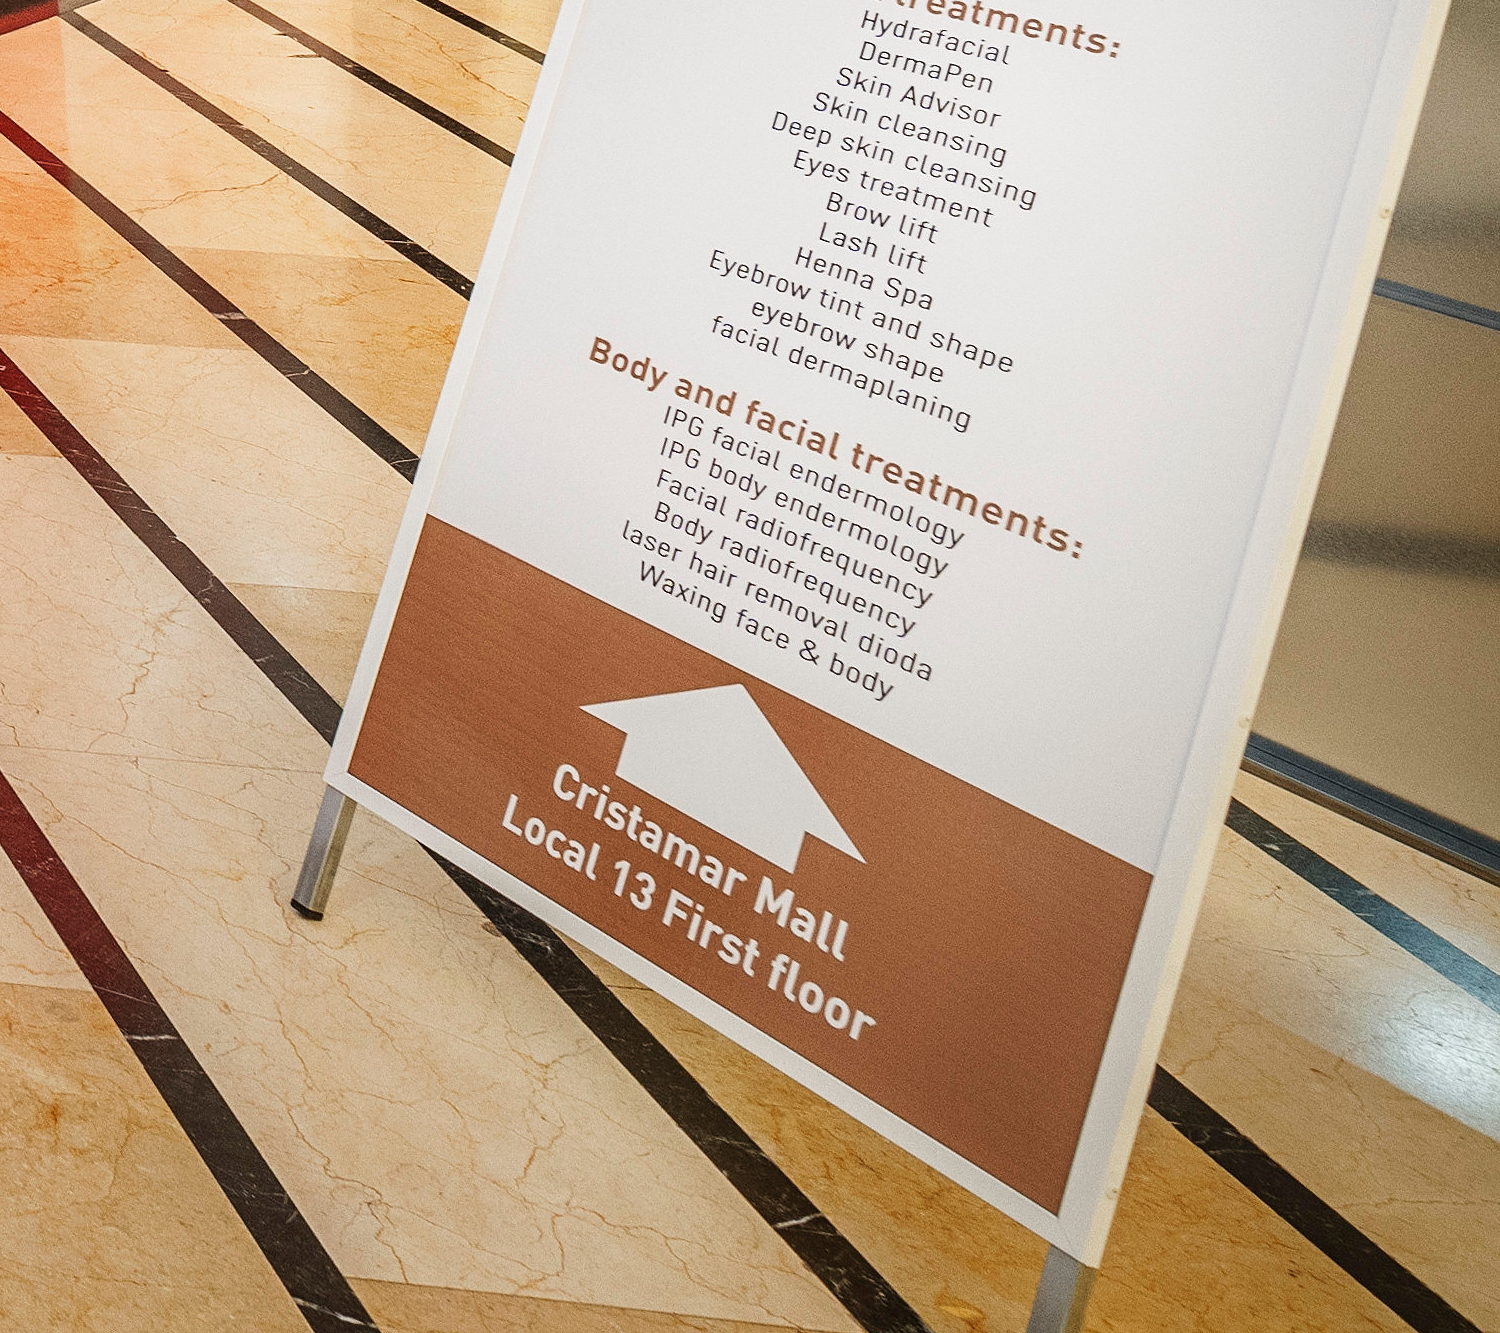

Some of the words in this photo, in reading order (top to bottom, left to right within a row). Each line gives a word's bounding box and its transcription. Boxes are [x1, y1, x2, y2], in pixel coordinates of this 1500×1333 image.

[859, 41, 993, 93] DermaPen
[861, 10, 1009, 65] Hydrafacial
[813, 92, 868, 124] Skin
[878, 114, 1007, 168] cleansing
[836, 67, 892, 98] Skin
[900, 85, 1001, 127] Advisor
[771, 111, 832, 148] Deep
[840, 136, 894, 164] skin
[904, 154, 1037, 211] cleansing
[793, 149, 850, 183] Eyes
[860, 171, 993, 228] treatment
[819, 222, 878, 258] Lash
[888, 244, 927, 274] lift
[826, 191, 891, 227] Brow
[899, 214, 938, 244] lift
[710, 249, 811, 300] Eyebrow
[820, 289, 864, 320] tint
[872, 312, 922, 340] and
[930, 332, 1013, 373] shape
[795, 246, 874, 290] Henna
[884, 277, 933, 310] Spa
[712, 315, 779, 357] facial
[788, 346, 971, 433] dermaplaning
[752, 302, 857, 350] eyebrow
[863, 343, 944, 383] shape
[589, 336, 668, 392] Body
[674, 378, 737, 417] and
[745, 400, 840, 460] facial
[852, 443, 1083, 559] treatments:
[663, 406, 704, 437] IPG
[712, 426, 780, 471] facial
[790, 463, 965, 549] endermology
[657, 469, 727, 516] Facial
[735, 508, 933, 609] radiofrequency
[660, 437, 701, 469] IPG
[709, 458, 767, 501] body
[775, 492, 949, 579] endermology
[622, 520, 682, 561] laser
[689, 551, 737, 587] hair
[745, 582, 848, 643] removal
[858, 633, 932, 681] dioda
[654, 501, 713, 545] Body
[720, 536, 916, 638] radiofrequency
[502, 794, 600, 881] Local
[614, 860, 656, 910] 13
[662, 889, 760, 977] First
[768, 954, 877, 1040] floor
[553, 764, 747, 896] Cristamar
[753, 876, 848, 962] Mall
